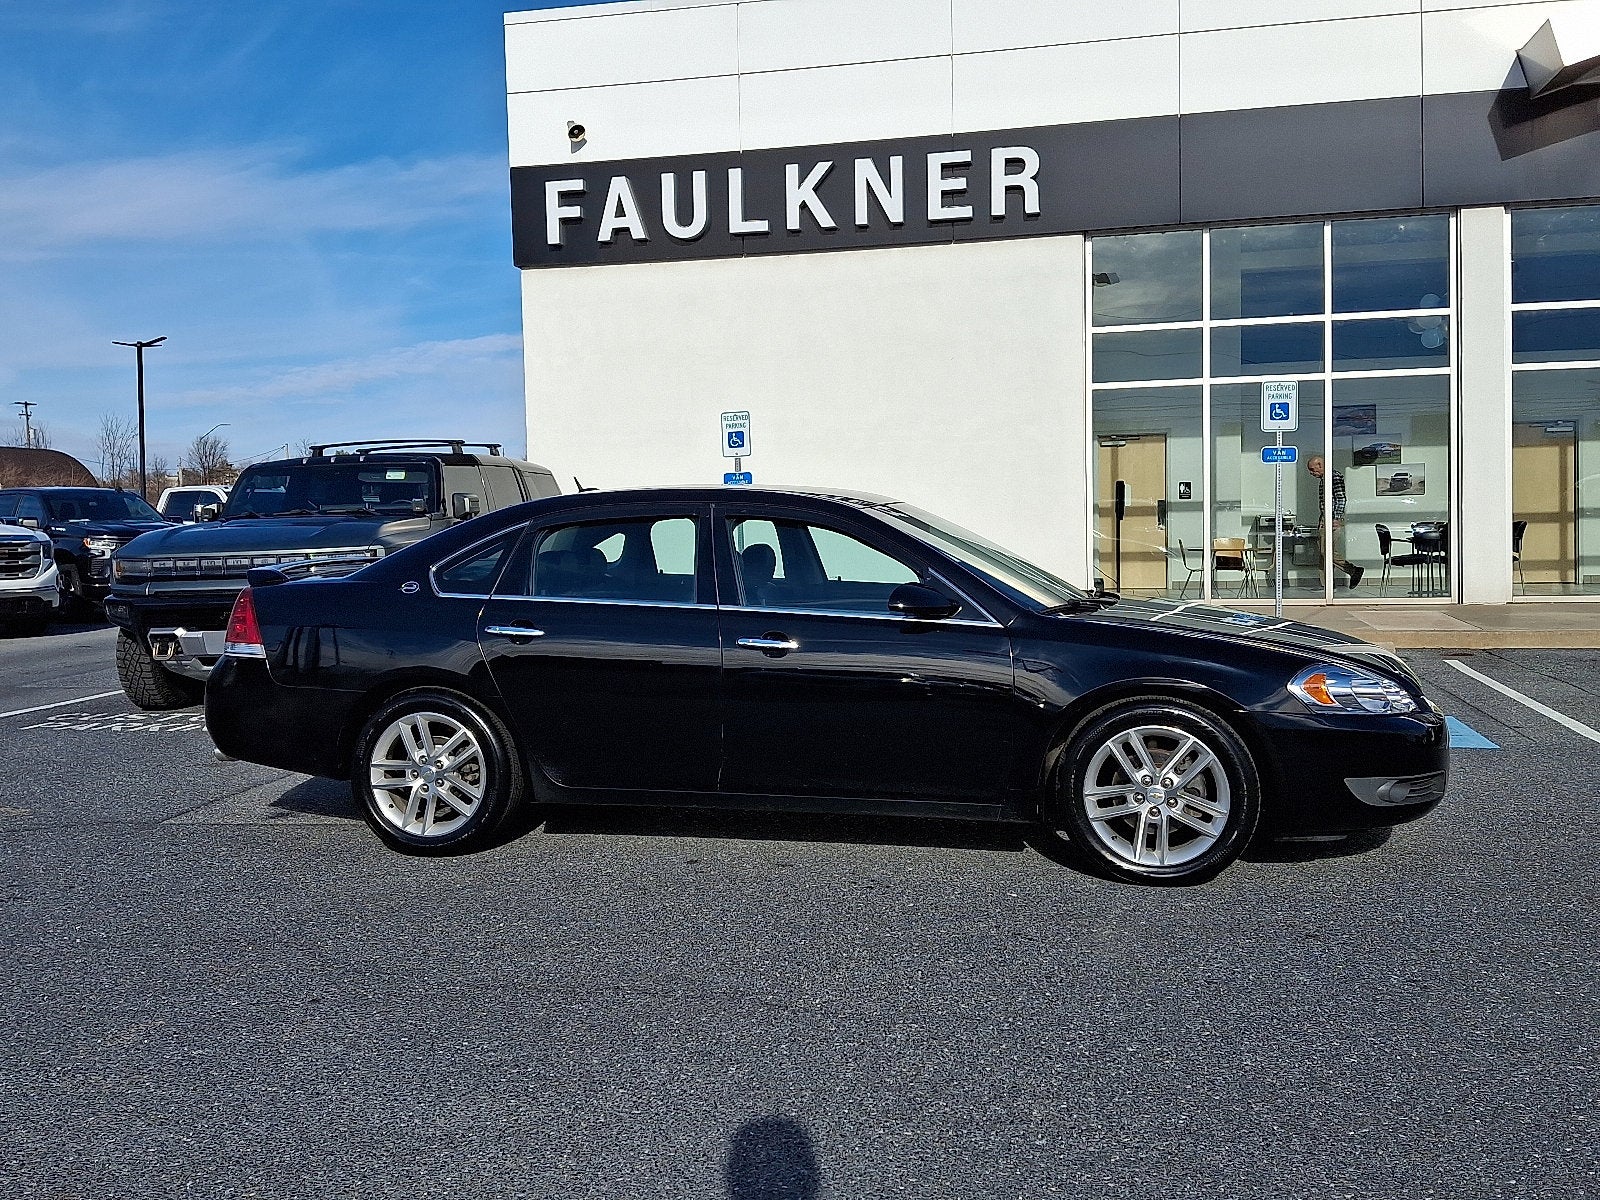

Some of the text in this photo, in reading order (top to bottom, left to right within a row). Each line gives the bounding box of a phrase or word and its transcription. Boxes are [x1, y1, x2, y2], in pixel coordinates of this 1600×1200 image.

[545, 146, 1041, 246] FAULKNER
[1265, 384, 1296, 392] RESERVED
[1267, 392, 1293, 400] PARKING
